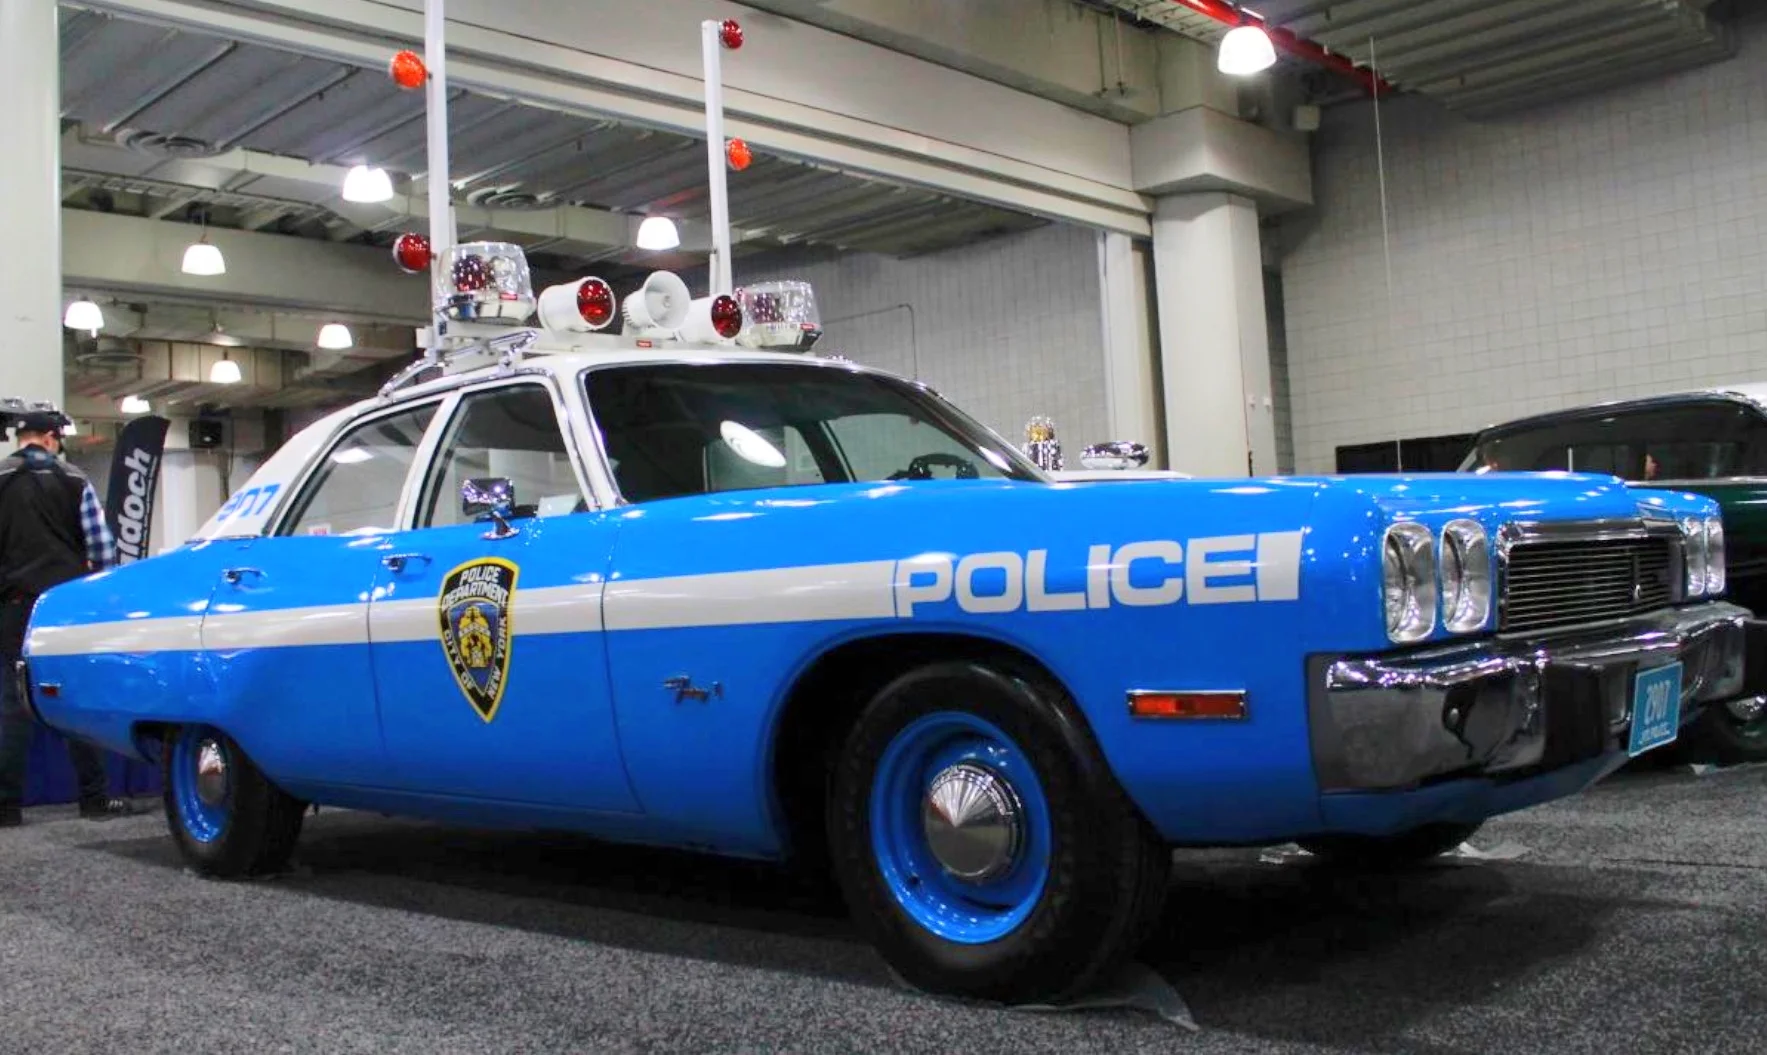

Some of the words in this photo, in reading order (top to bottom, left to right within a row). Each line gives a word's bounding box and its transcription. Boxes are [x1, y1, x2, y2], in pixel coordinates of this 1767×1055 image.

[460, 566, 502, 585] POLICE
[895, 533, 1257, 618] POLICE
[441, 582, 509, 611] DEPARTMENT
